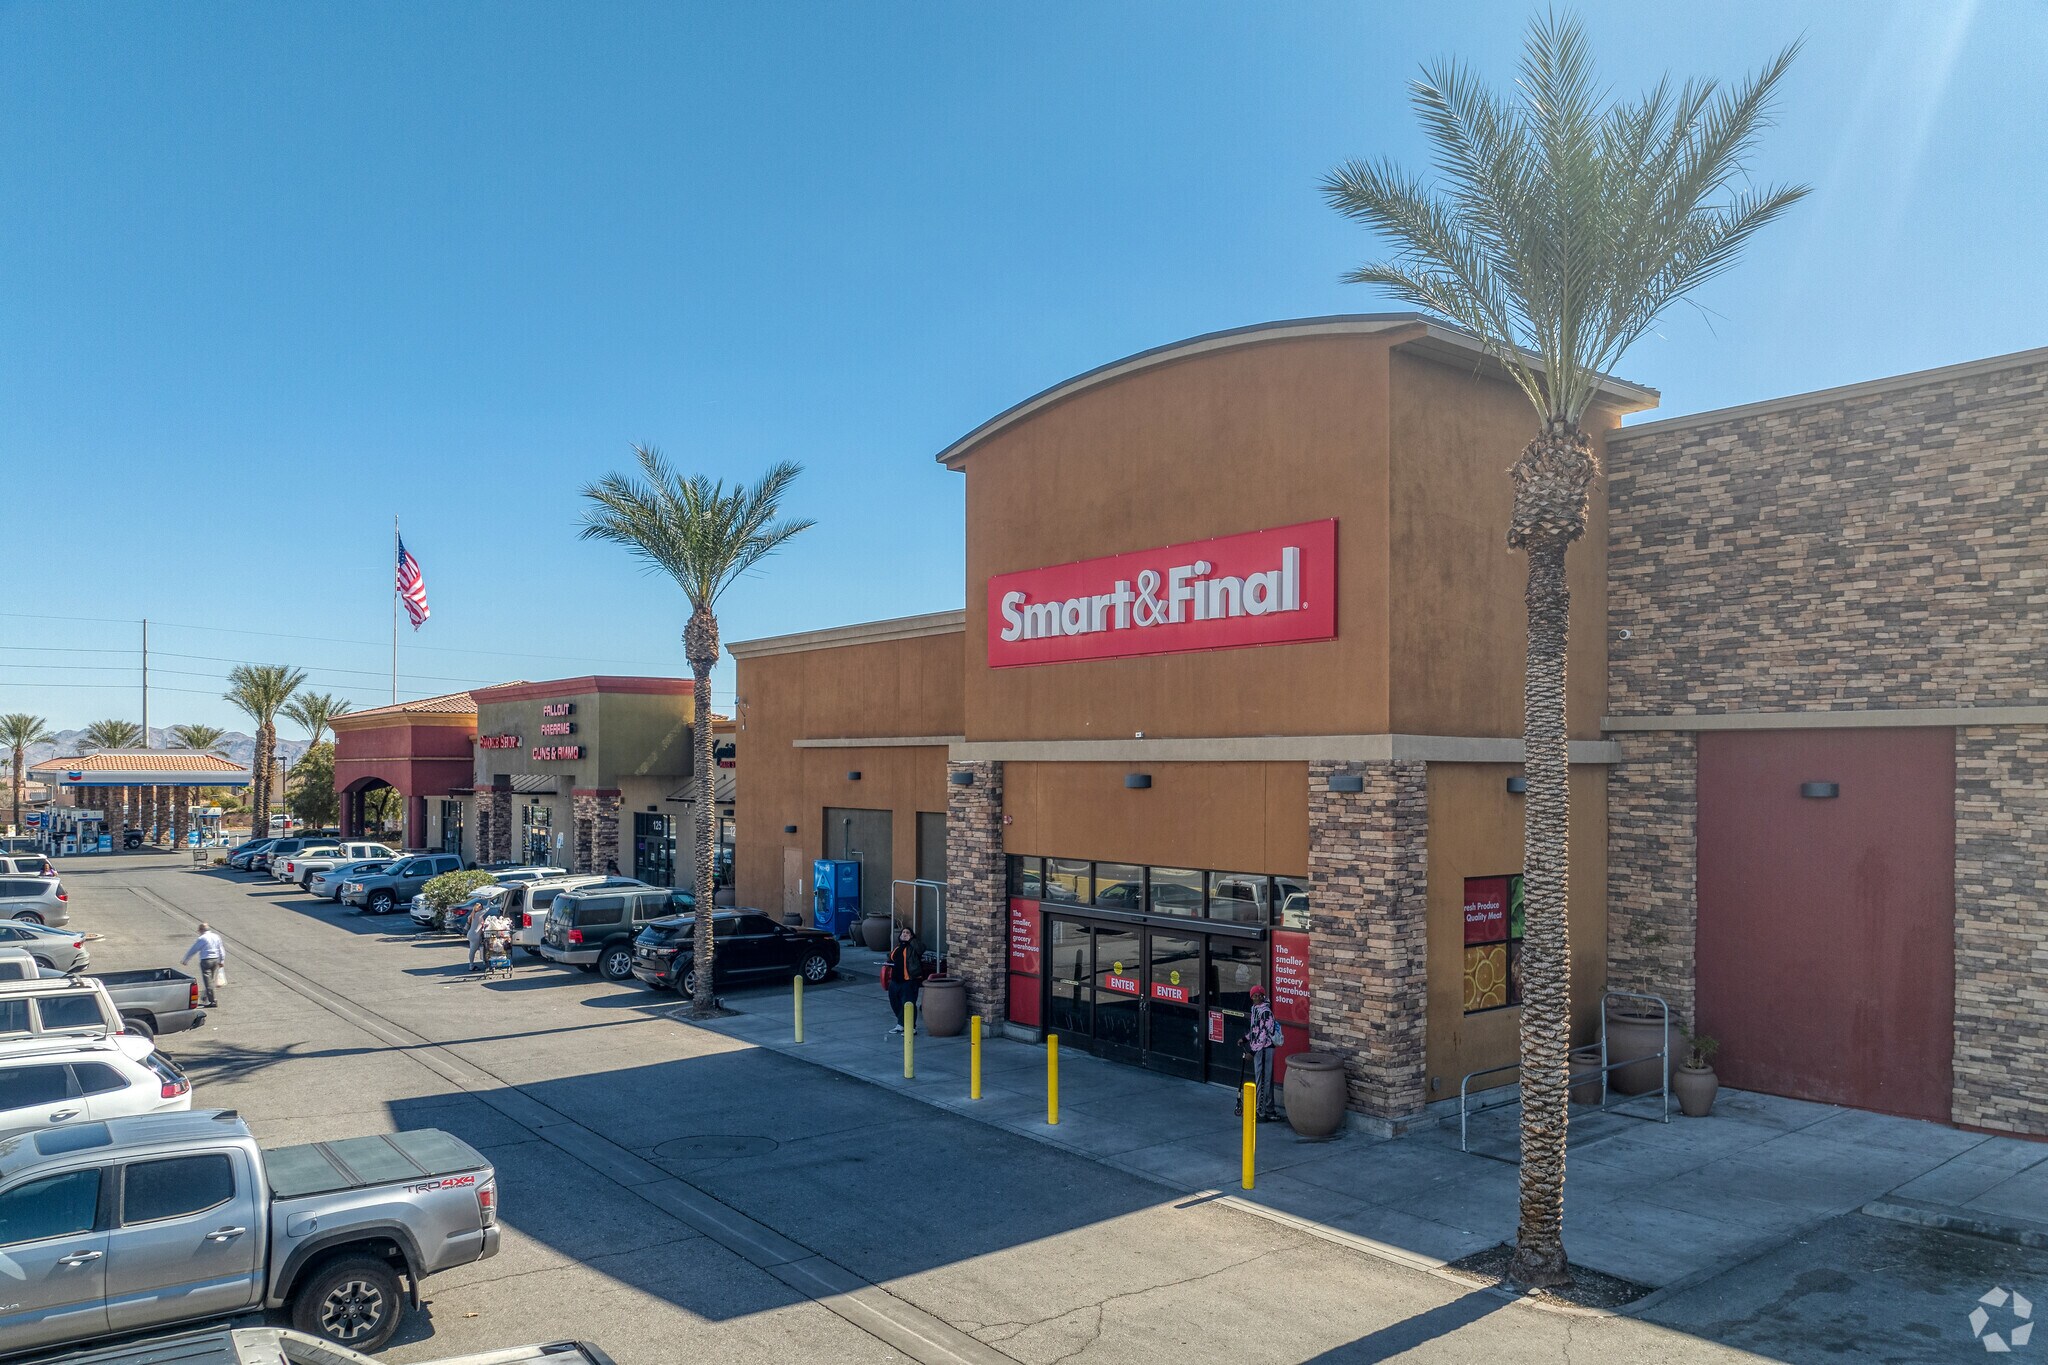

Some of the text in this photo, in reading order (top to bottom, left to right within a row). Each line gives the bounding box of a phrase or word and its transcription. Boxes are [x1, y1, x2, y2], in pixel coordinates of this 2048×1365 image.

[543, 703, 570, 717] FALLOUT
[541, 722, 570, 736] FIREARMS
[500, 734, 517, 749] SHOP
[532, 745, 579, 761] GUNS & AMMO
[653, 820, 662, 831] 125
[1463, 901, 1500, 912] resh Produce
[1012, 909, 1022, 917] The
[1466, 912, 1503, 923] Quality Meat
[1012, 918, 1032, 928] smaller,
[1012, 925, 1027, 934] faster
[1012, 935, 1032, 945] grocery
[1012, 943, 1040, 953] warehouse
[1275, 944, 1289, 954] The
[1275, 956, 1304, 967] smaller,
[1275, 964, 1297, 975] faster
[1111, 977, 1135, 992] ENTER
[1275, 976, 1304, 988] grocery
[1157, 985, 1183, 1000] ENTER
[1275, 995, 1294, 1005] store
